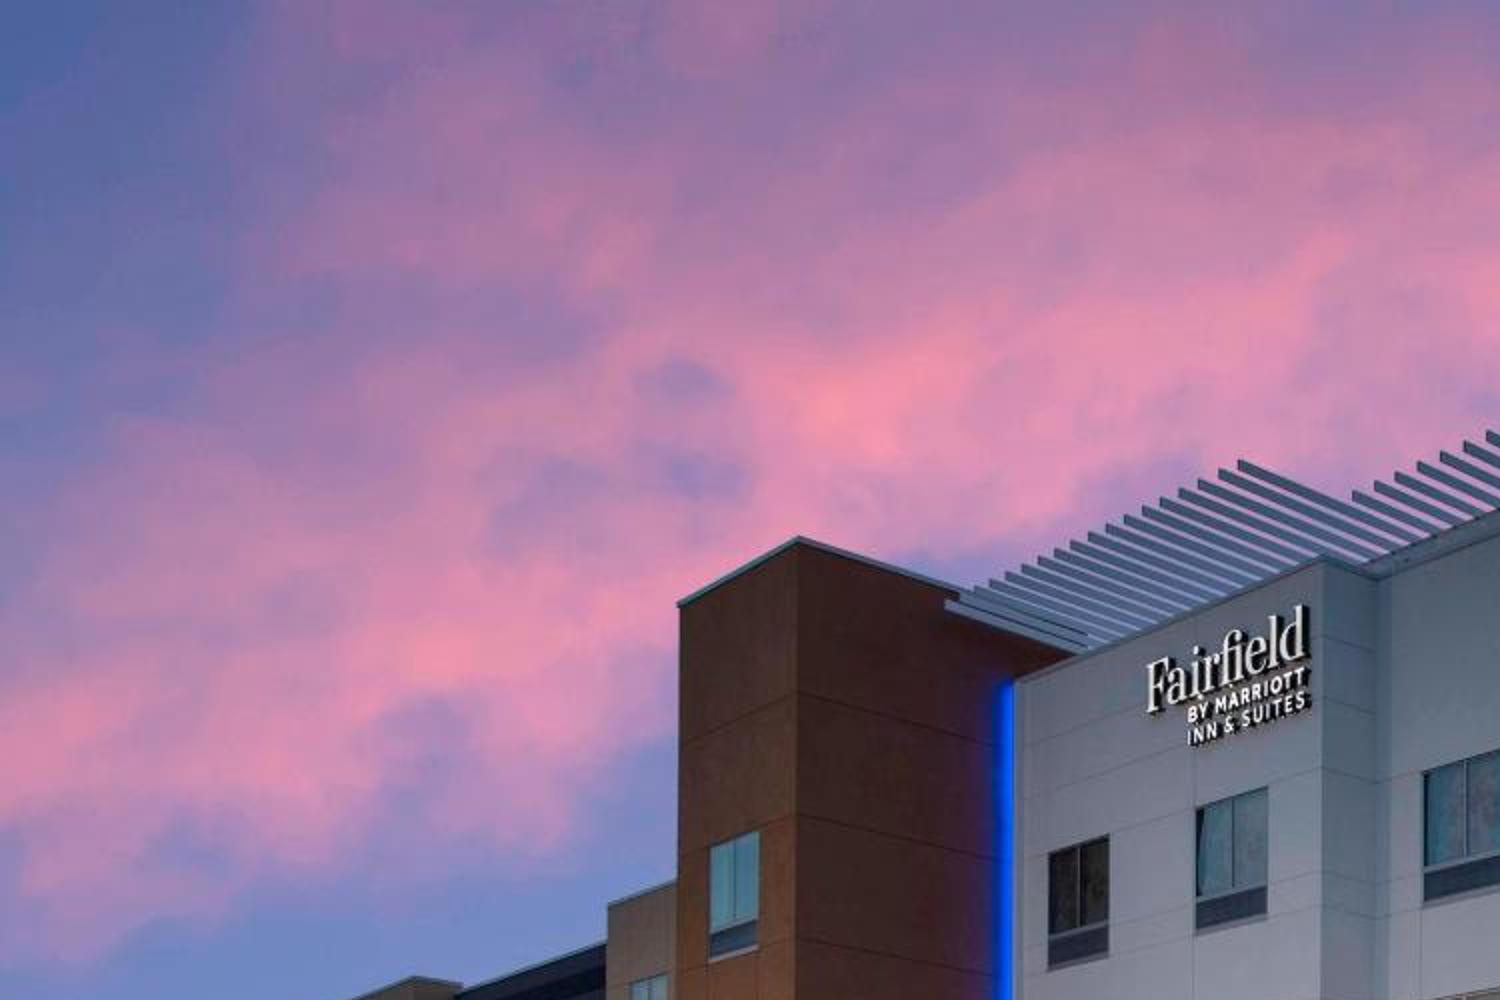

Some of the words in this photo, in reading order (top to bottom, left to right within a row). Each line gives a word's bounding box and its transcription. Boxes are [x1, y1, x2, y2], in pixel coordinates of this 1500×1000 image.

[1146, 604, 1305, 713] Fairfield
[1187, 702, 1209, 723] BY
[1215, 667, 1305, 714] MARRIOTT
[1187, 722, 1217, 745] INN
[1224, 715, 1234, 733] &
[1242, 691, 1305, 727] SUITES
